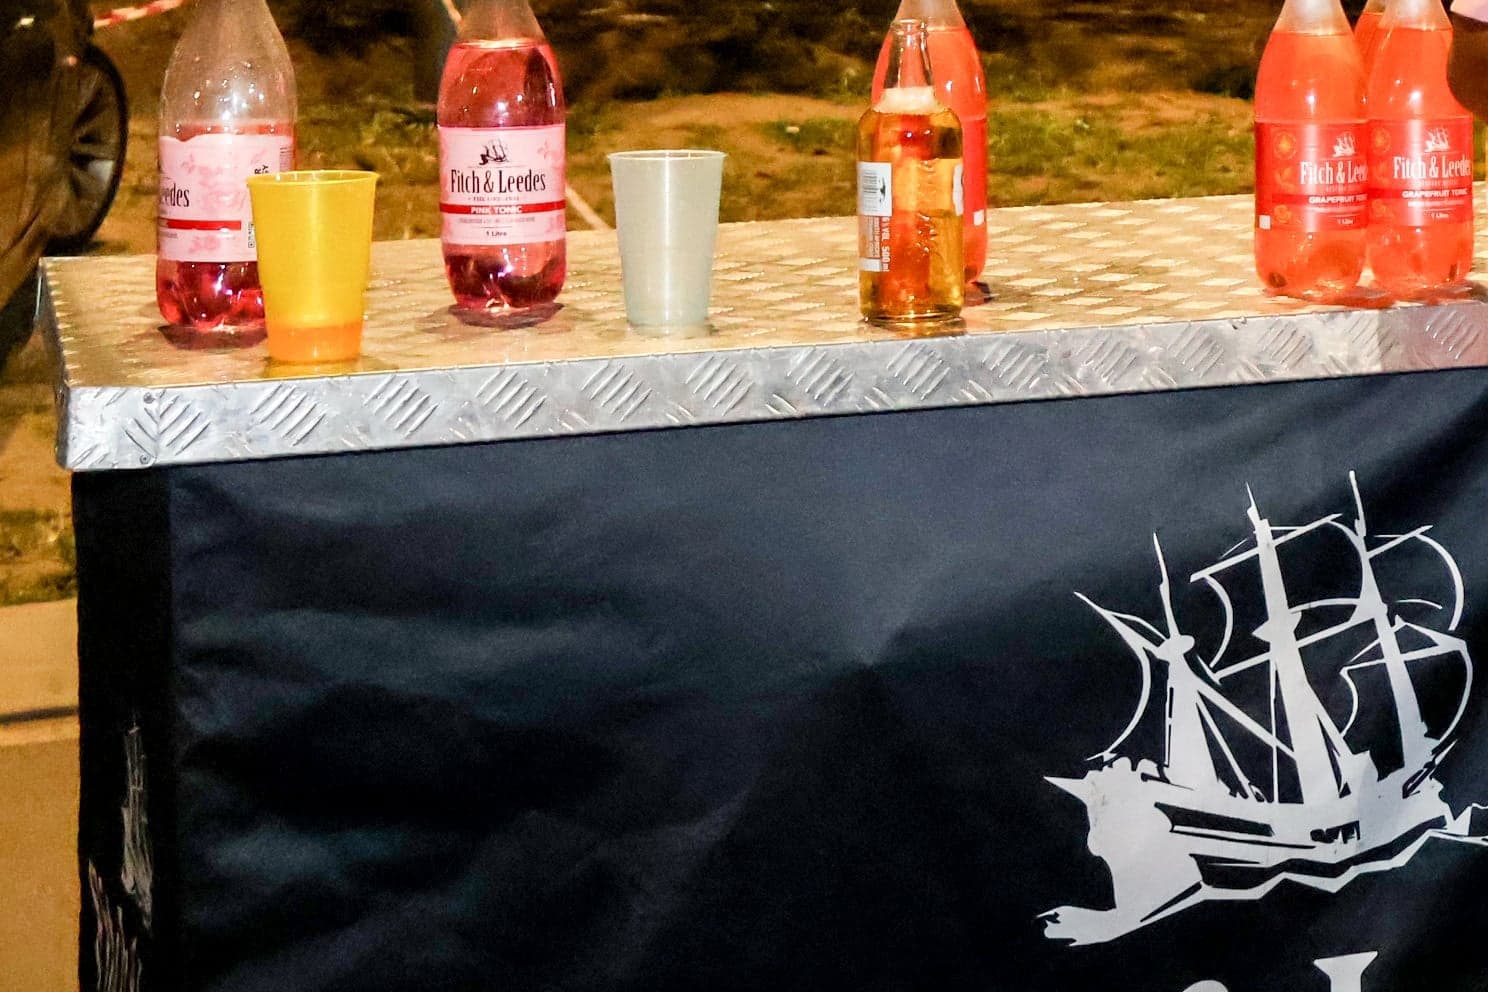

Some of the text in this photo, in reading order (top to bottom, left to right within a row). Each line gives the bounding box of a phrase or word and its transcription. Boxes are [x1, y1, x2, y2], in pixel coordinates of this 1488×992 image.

[1300, 161, 1334, 185] Fitch
[1336, 160, 1346, 184] &
[1393, 156, 1427, 179] Fitch
[1429, 155, 1440, 178] &
[451, 168, 546, 194] Fitch & Leedes
[1402, 189, 1450, 198] GRAPEFRUIT
